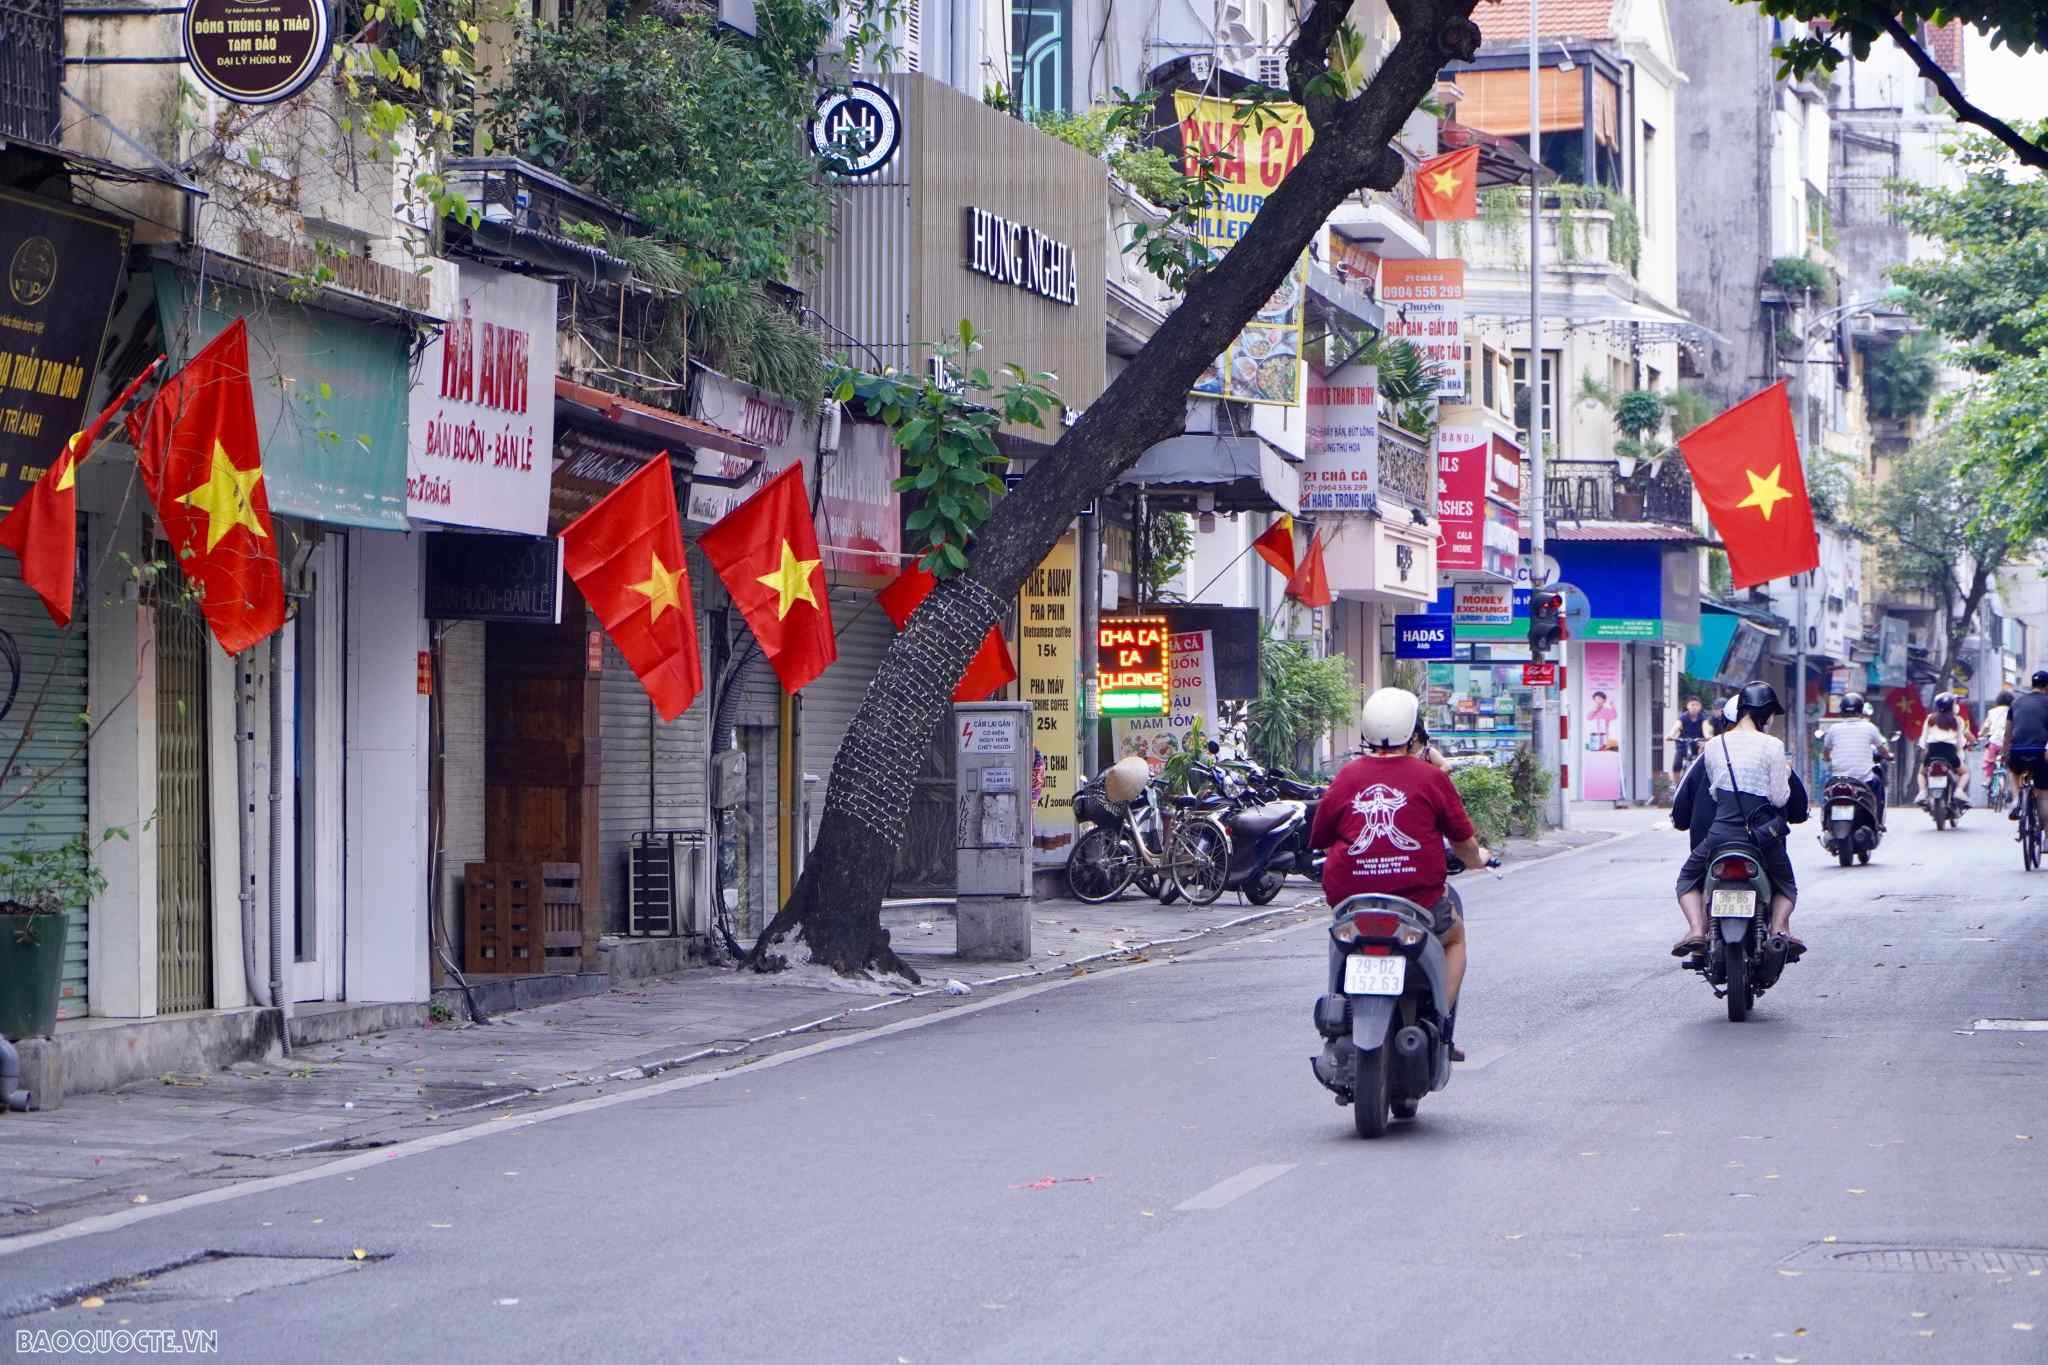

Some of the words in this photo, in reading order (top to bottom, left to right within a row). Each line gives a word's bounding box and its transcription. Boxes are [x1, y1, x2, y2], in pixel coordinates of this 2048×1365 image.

[195, 19, 225, 34] ĐÔNG
[228, 17, 263, 33] TRÙNG
[265, 20, 280, 34] HẠ
[283, 15, 310, 31] THẢO
[228, 39, 252, 52] TAM
[254, 34, 278, 51] ĐẢO
[217, 57, 234, 67] ĐẠI
[235, 55, 248, 65] LÝ
[249, 55, 276, 66] HÙNG
[279, 55, 292, 63] NX
[974, 207, 1022, 286] HUNG
[1028, 226, 1079, 306] NGHIA
[10, 344, 40, 392] THẢO
[37, 358, 64, 395] TAM
[60, 355, 84, 399] ĐẢO
[478, 321, 529, 414] ANH
[18, 411, 42, 437] ANH
[426, 410, 451, 458] BÁN
[454, 419, 485, 462] BUÔN
[494, 424, 518, 468] BÁN
[1439, 457, 1459, 473] ILS
[1304, 472, 1317, 481] 21
[1335, 493, 1360, 508] TRONG
[1438, 500, 1473, 517] ASHES
[1047, 568, 1071, 597] AWAY
[1462, 594, 1504, 604] MONEY
[1030, 603, 1045, 620] PHA
[1047, 603, 1065, 621] PHIN
[1457, 605, 1509, 613] EXCHANGE
[1403, 629, 1445, 642] HADAS
[1037, 643, 1057, 657] 15k
[1030, 678, 1045, 694] PHA
[1047, 674, 1064, 694] MÁY
[1050, 699, 1069, 711] COFFEE
[1173, 693, 1192, 711] ẬU
[1037, 716, 1057, 730] 25k
[1050, 755, 1068, 771] CHAI
